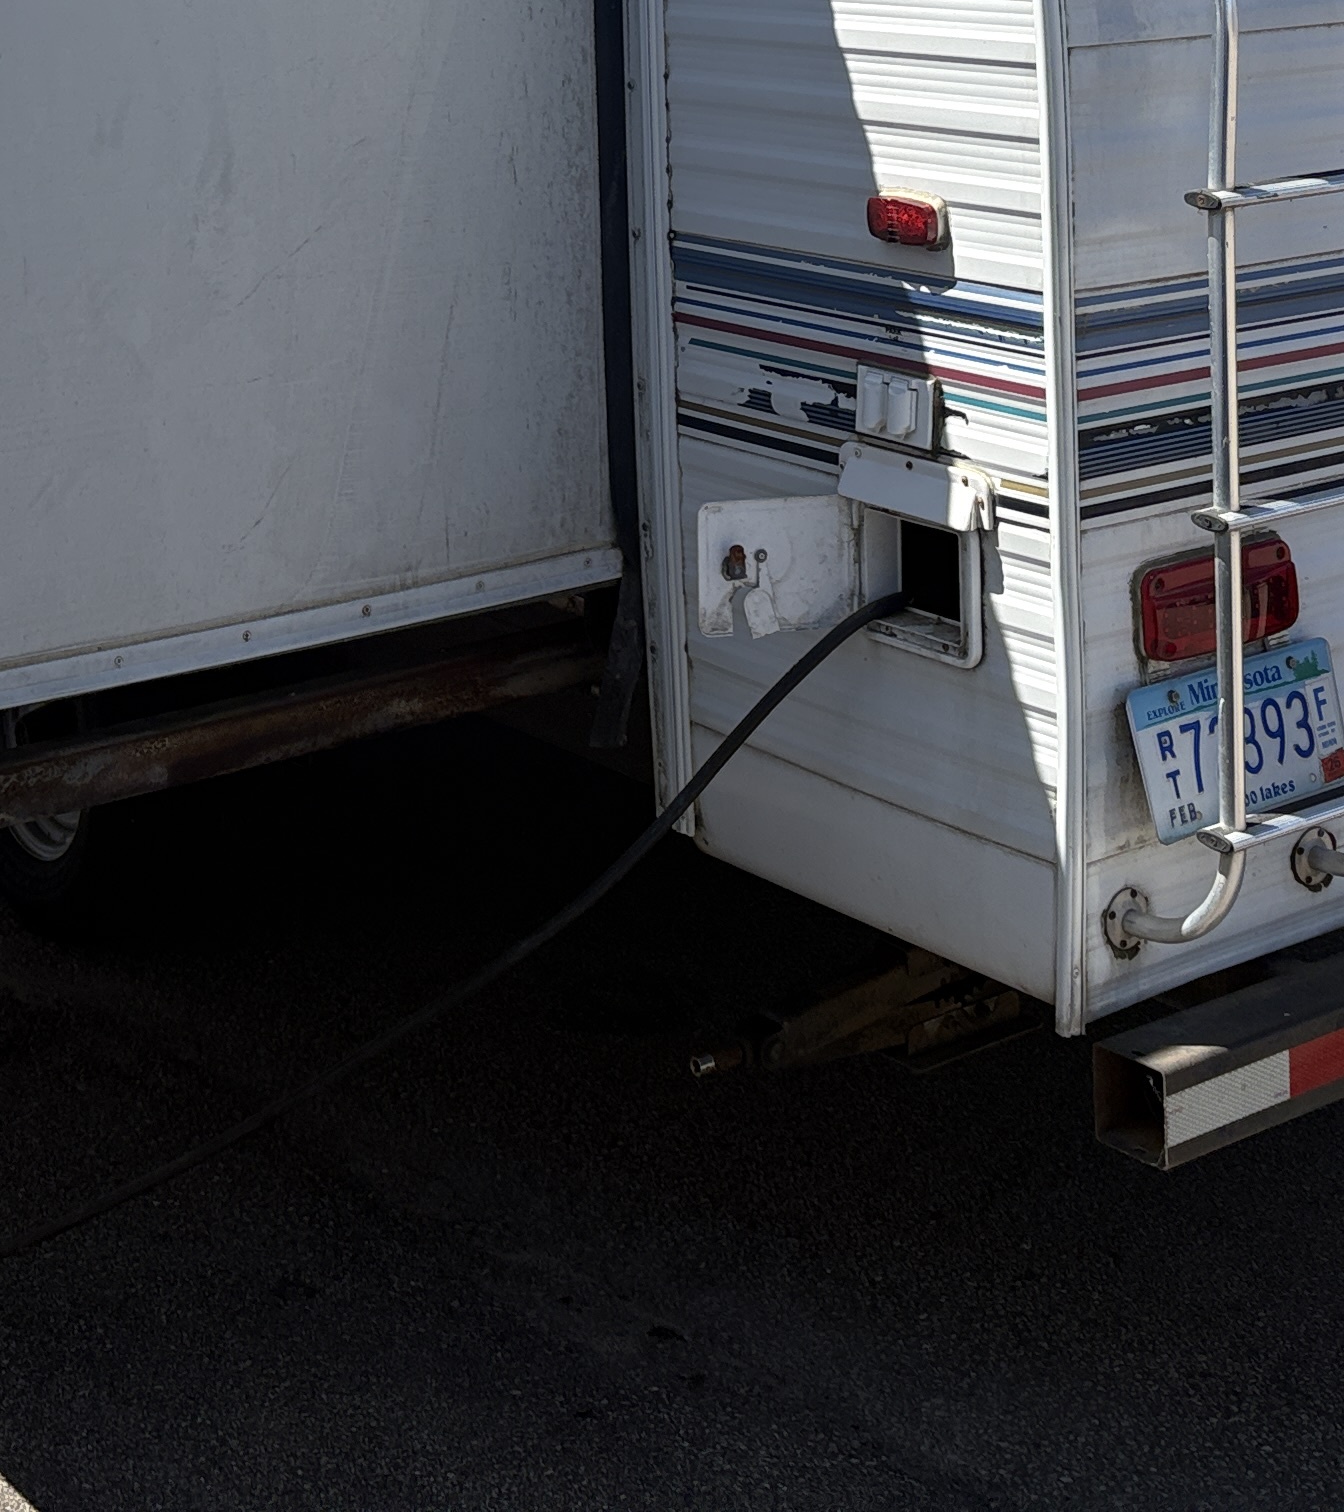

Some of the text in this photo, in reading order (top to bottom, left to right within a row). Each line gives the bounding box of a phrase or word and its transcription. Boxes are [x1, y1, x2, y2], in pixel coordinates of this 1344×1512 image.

[1147, 701, 1185, 720] EXPLORE
[1260, 780, 1295, 802] lakes
[1169, 802, 1198, 829] FEB
